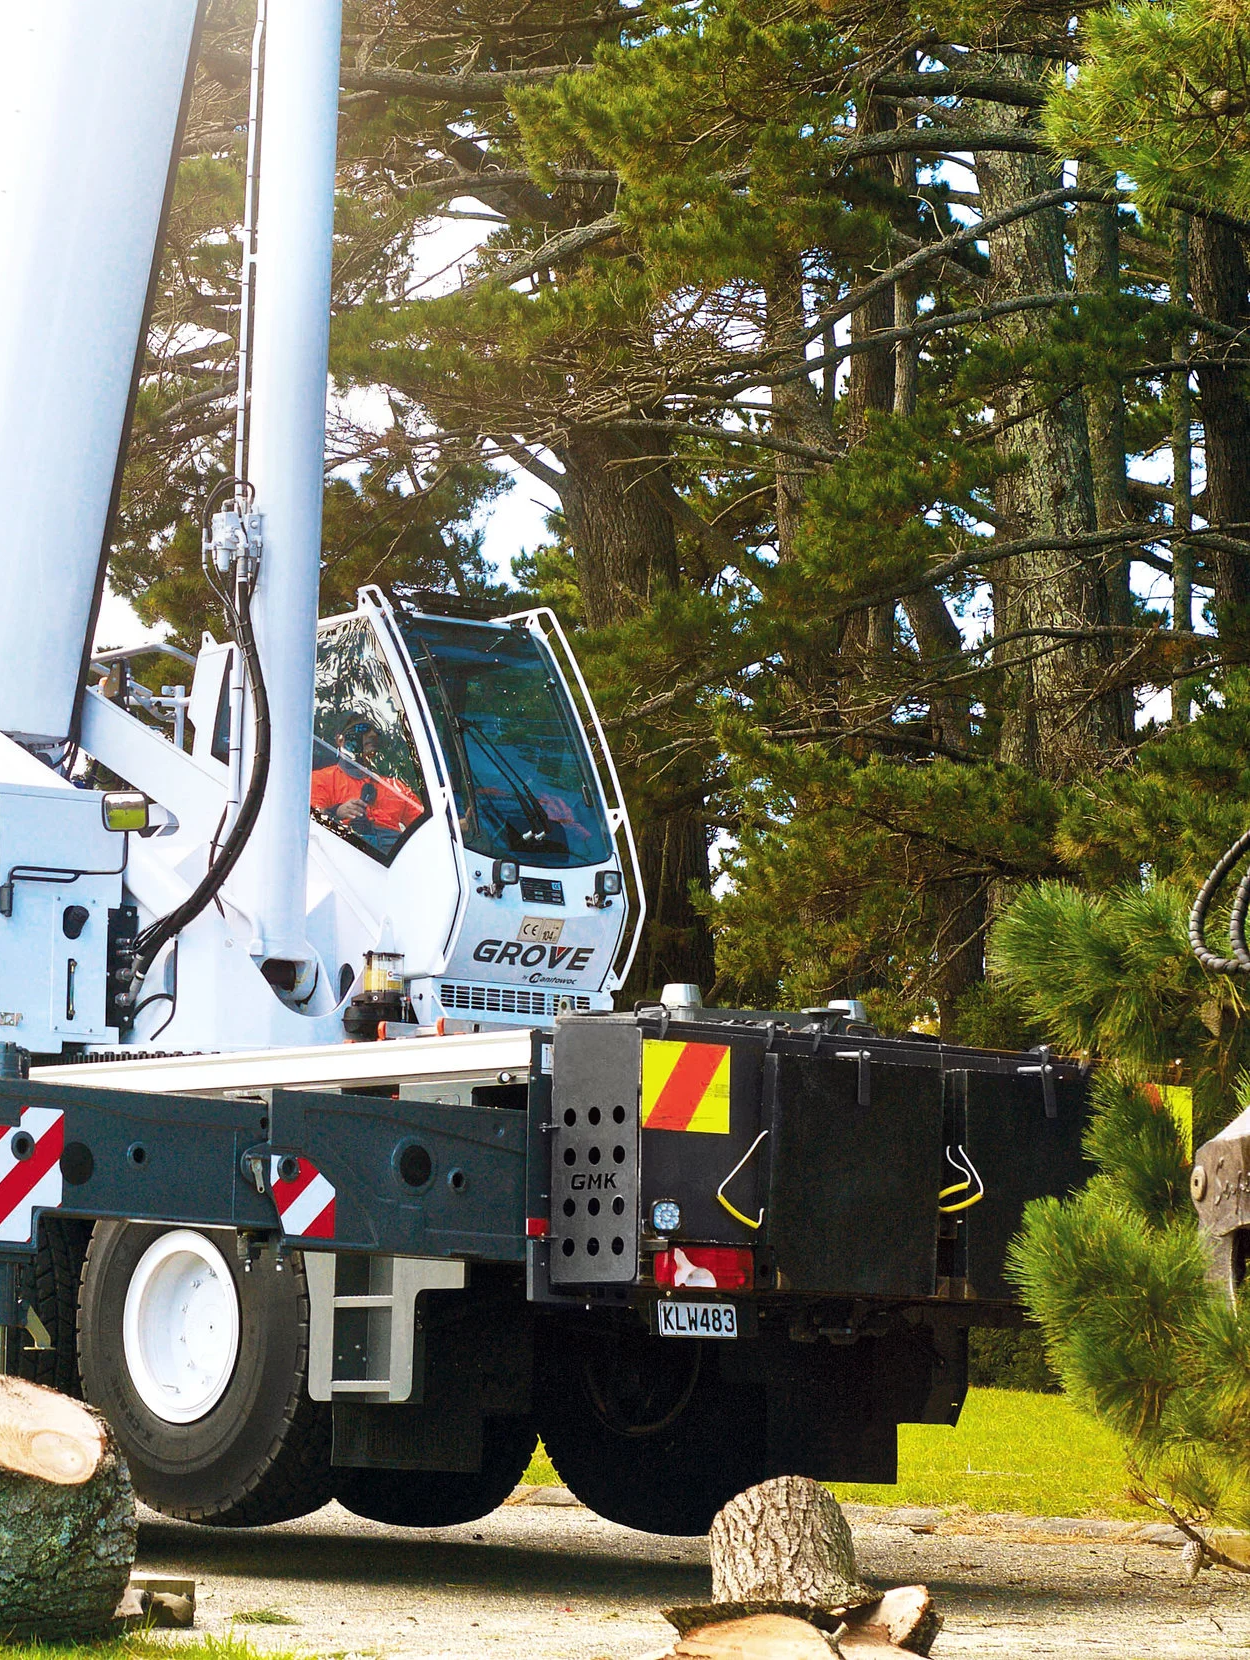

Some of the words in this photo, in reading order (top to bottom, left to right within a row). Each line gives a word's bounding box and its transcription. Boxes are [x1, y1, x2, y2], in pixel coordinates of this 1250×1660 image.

[473, 939, 595, 970] GROVE
[571, 1173, 617, 1190] GMK
[663, 1306, 735, 1333] KLW483
